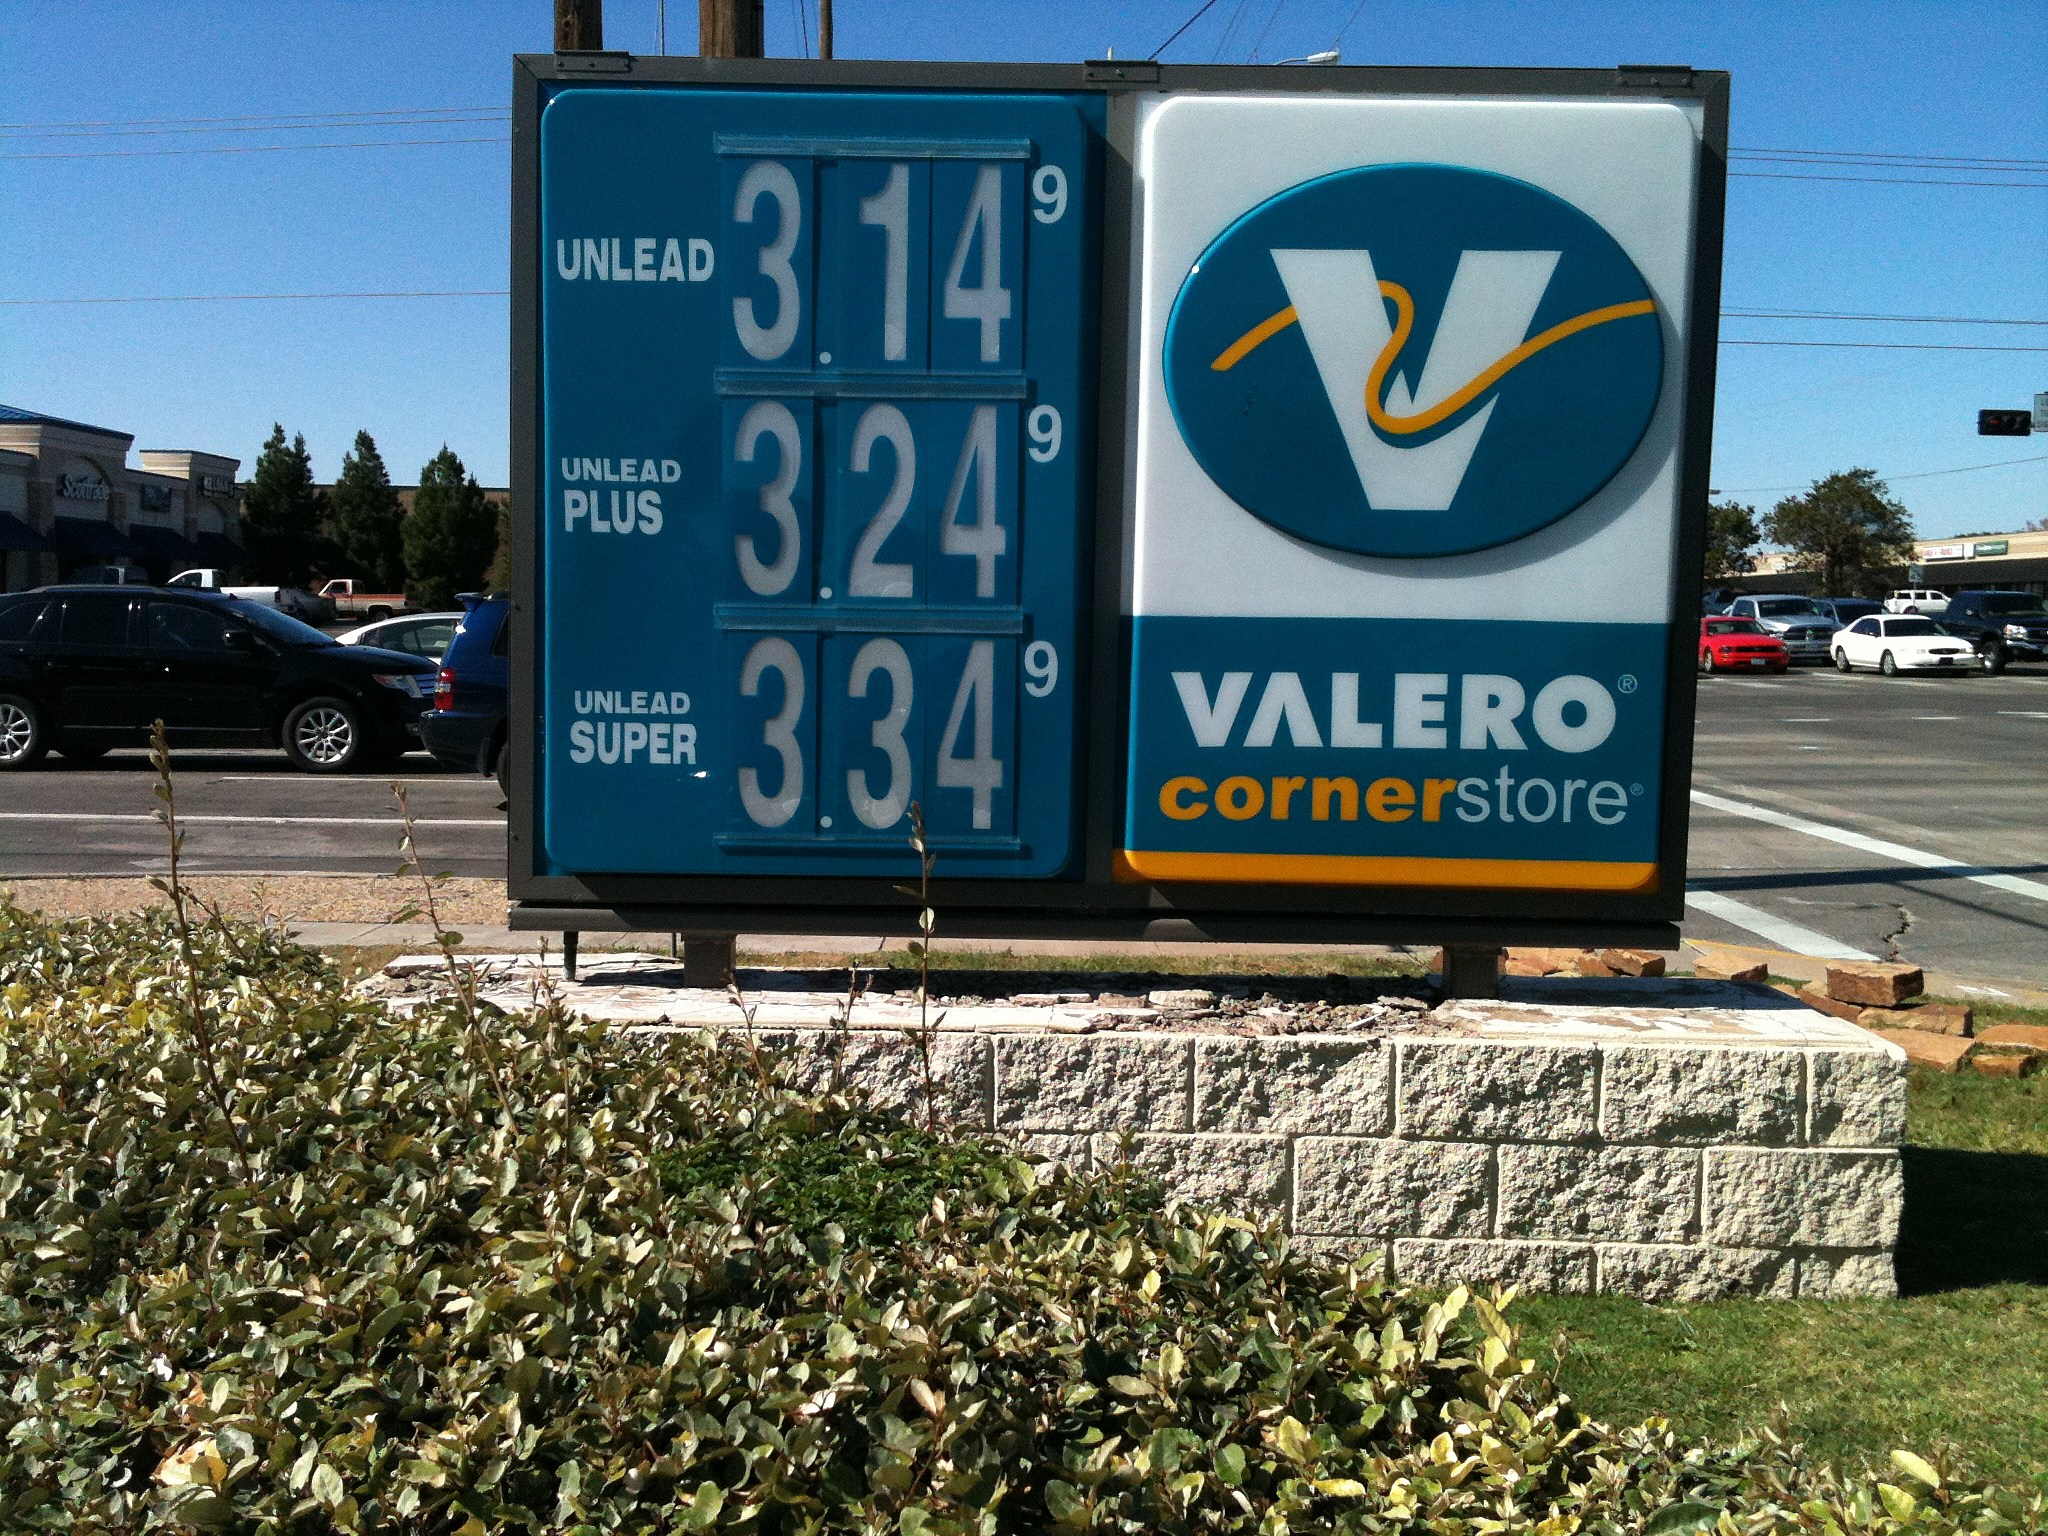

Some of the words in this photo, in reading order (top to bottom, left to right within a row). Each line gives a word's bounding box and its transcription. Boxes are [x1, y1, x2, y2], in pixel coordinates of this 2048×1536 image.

[557, 238, 715, 281] UNLEAD
[561, 457, 682, 483] UNLEAD
[564, 489, 664, 535] PLUS
[574, 690, 691, 715] UNLEAD
[569, 720, 698, 765] SUPER
